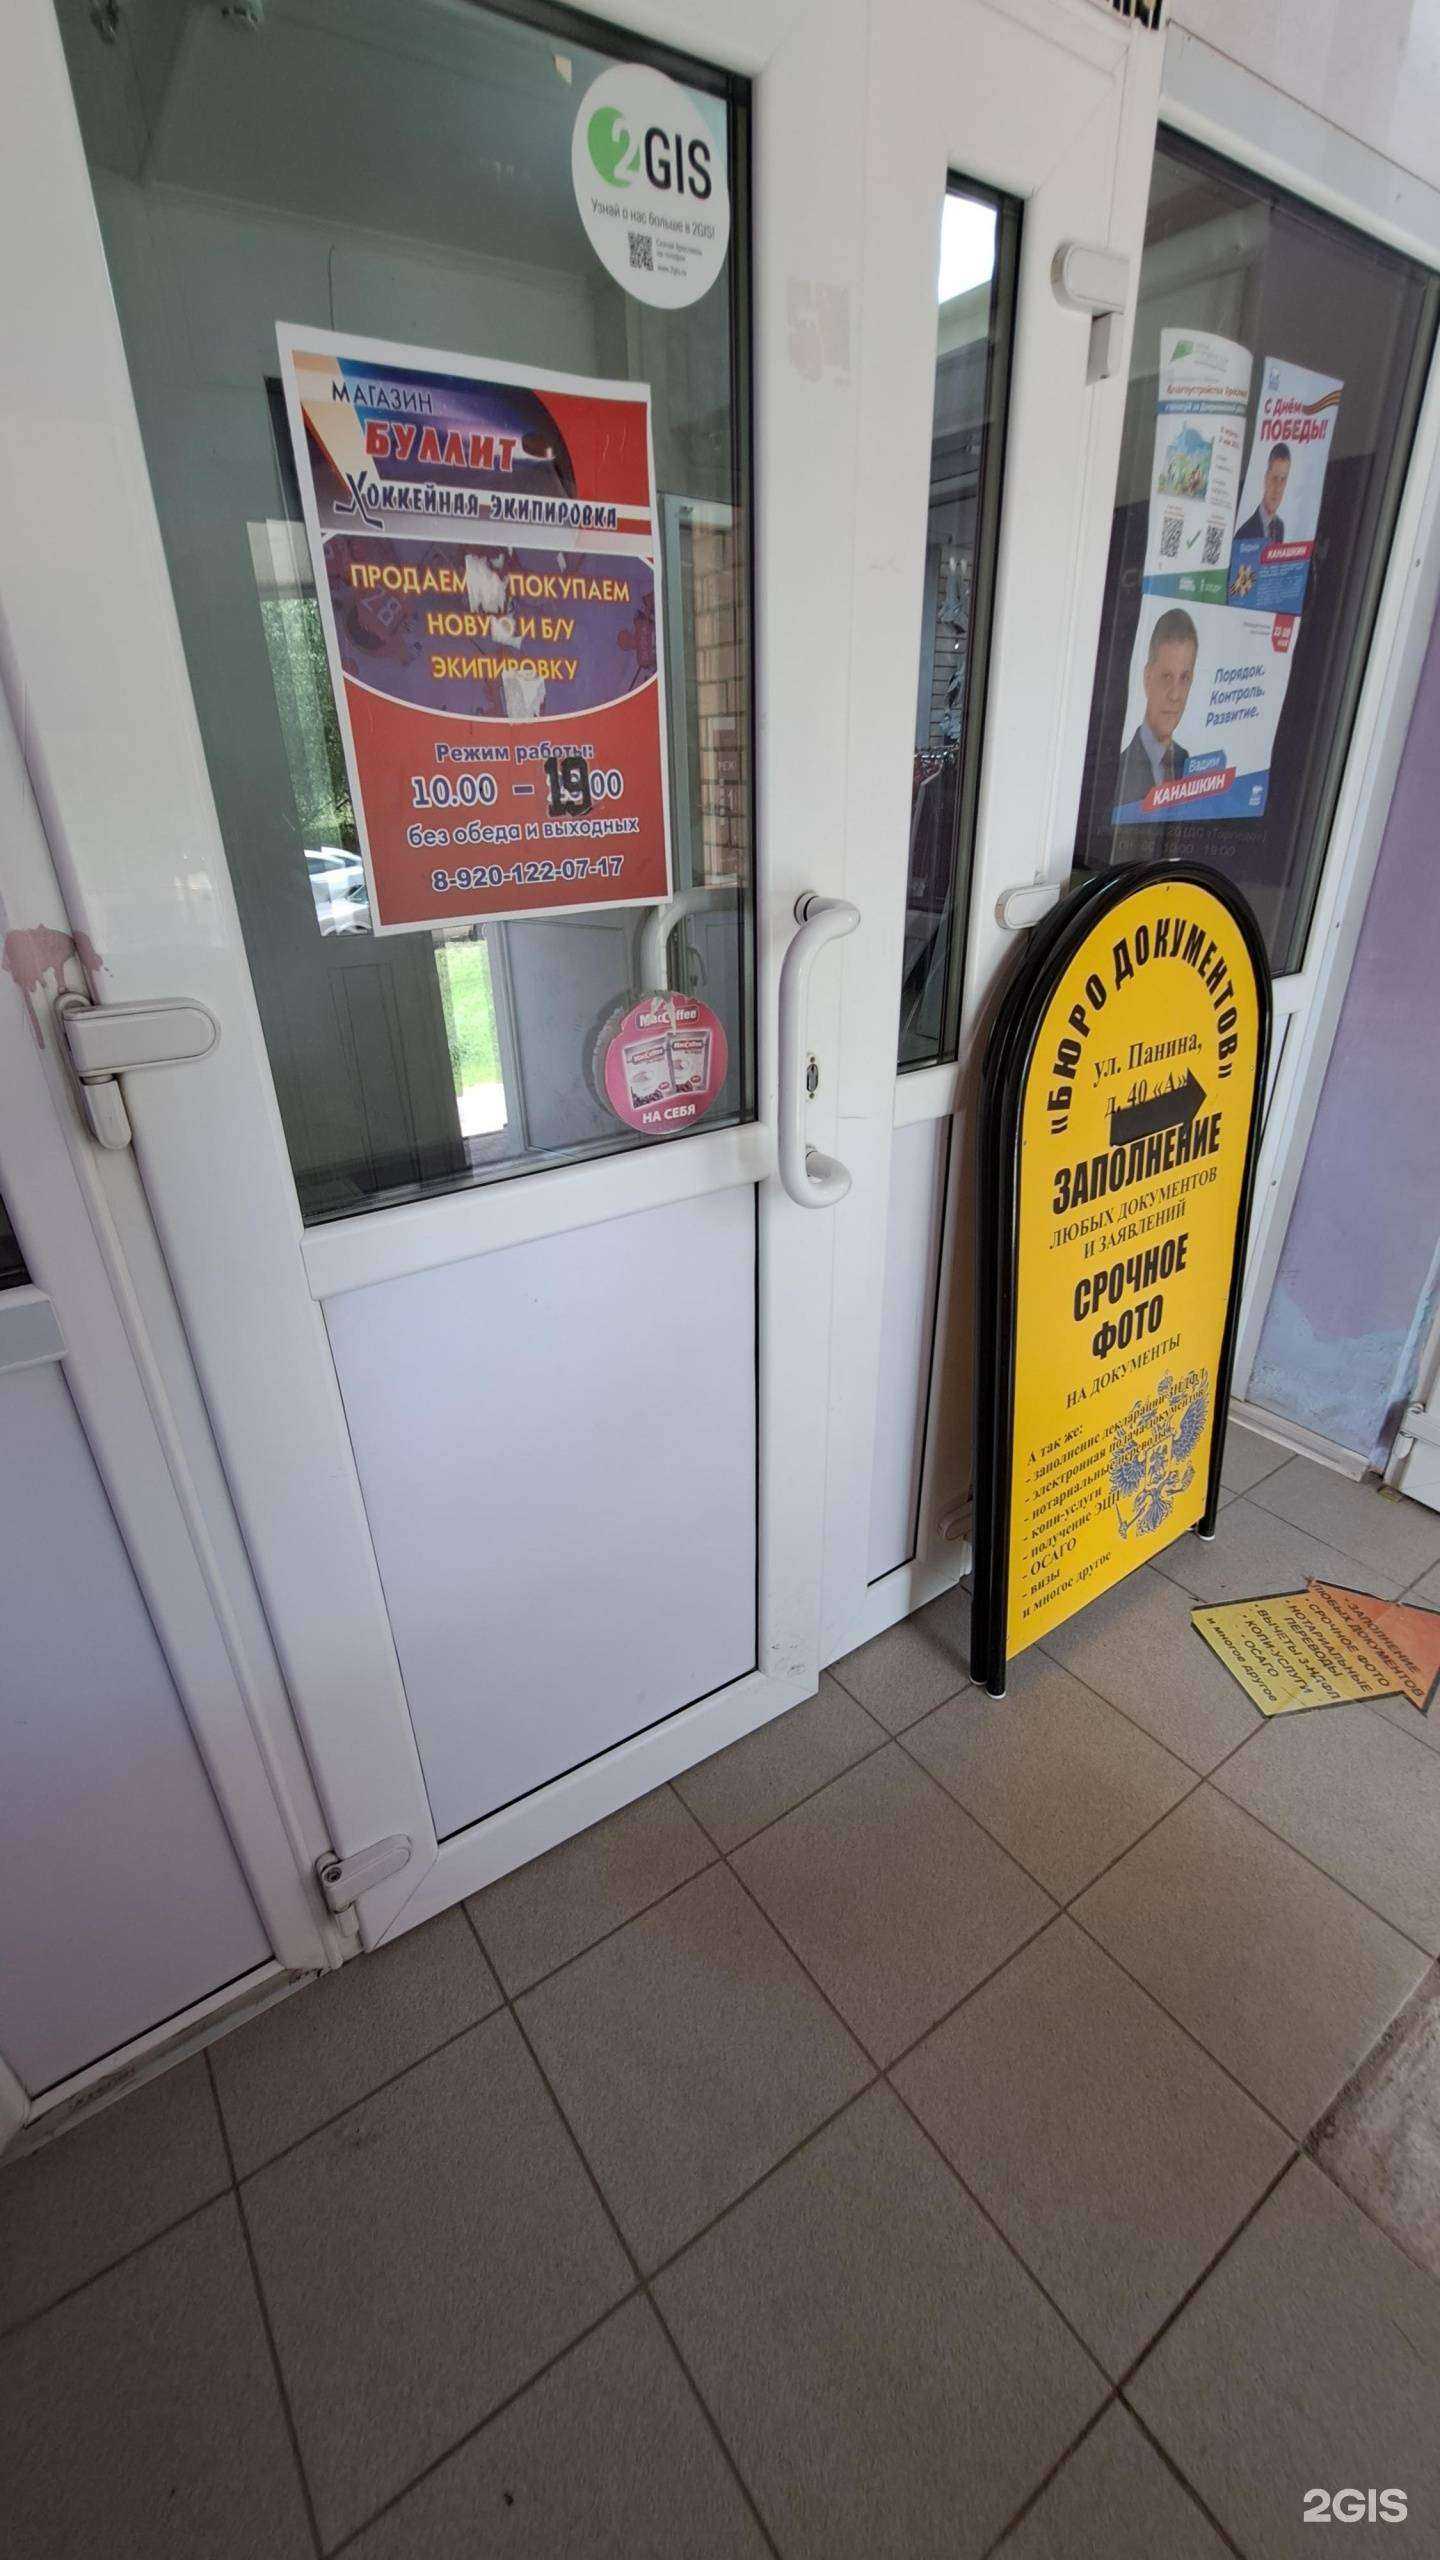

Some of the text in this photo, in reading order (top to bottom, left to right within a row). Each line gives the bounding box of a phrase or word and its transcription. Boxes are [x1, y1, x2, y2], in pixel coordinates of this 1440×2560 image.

[587, 105, 712, 200] 2GIS
[591, 199, 620, 218] Узнай
[622, 208, 628, 220] о
[630, 209, 646, 225] нас
[648, 211, 684, 233] больше
[331, 380, 433, 413] МАГАЗИН
[1264, 400, 1273, 413] С
[363, 417, 520, 473] БУЛЛИТ
[1260, 419, 1328, 443] ПОБЕДЫ!
[333, 470, 618, 531] ХОККЕЙНАЯ ЭКИПИРОВКА
[350, 563, 631, 602] ПРОДАЕМ ПОКУПАЕМ
[520, 618, 535, 640] И
[541, 617, 575, 642] Б/У
[431, 656, 578, 680] ЭКИПИРОВКУ
[1214, 664, 1265, 684] Порядок.
[1205, 705, 1259, 727] Развитие.
[1209, 686, 1265, 706] Контроль.
[436, 741, 594, 766] Режим работы:
[411, 775, 498, 808] 10.00
[1152, 773, 1226, 805] КАНАШКИН
[408, 817, 640, 847] без обеда и выходных
[432, 856, 625, 891] 8-920-122-07-17
[1093, 1033, 1202, 1087] ул. Панина,
[642, 1104, 696, 1124] НА СЕБЯ
[1127, 1079, 1147, 1105] 40
[1052, 1112, 1222, 1215] ЗАПОЛНЕНИЕ
[1049, 1166, 1217, 1249] ЛЮБЫХ ДОКУМЕНТОВ
[1083, 1199, 1187, 1259] И ЗАЯВЛЕНИЙ
[1072, 1232, 1189, 1322] СРОЧНОЕ
[1092, 1294, 1164, 1361] ФОТО
[1065, 1333, 1182, 1409] НА ДОКУМЕНТЫ
[1027, 1424, 1083, 1466] А так же:
[1033, 1433, 1100, 1480] заполнение
[1032, 1448, 1106, 1500] электронная
[1032, 1461, 1114, 1520] нотариальные
[1031, 1487, 1102, 1539] копи-услуги
[1031, 1512, 1091, 1558] получение
[1030, 1537, 1077, 1576] ОСАГО
[1022, 1551, 1111, 1619] и многое другое
[1030, 1569, 1061, 1595] визы
[1246, 1620, 1314, 1694] КОПИ-УСЛУГИ
[1257, 1609, 1301, 1658] ВЫЧЕТЫ
[1284, 1616, 1343, 1678] ПЕРЕВОДЫ
[1289, 1605, 1373, 1694] НОТАРИАЛЬНЫЕ
[1308, 1603, 1390, 1688] СРОЧНОЕ ФОТО
[1347, 1602, 1422, 1675] ЗАПОЛНЕНИЕ
[1214, 1626, 1246, 1663] многое
[1241, 1658, 1277, 1702] другое
[1244, 1640, 1280, 1678] ОСАГО
[1347, 1622, 1424, 1697] ДОКУМЕНТОВ
